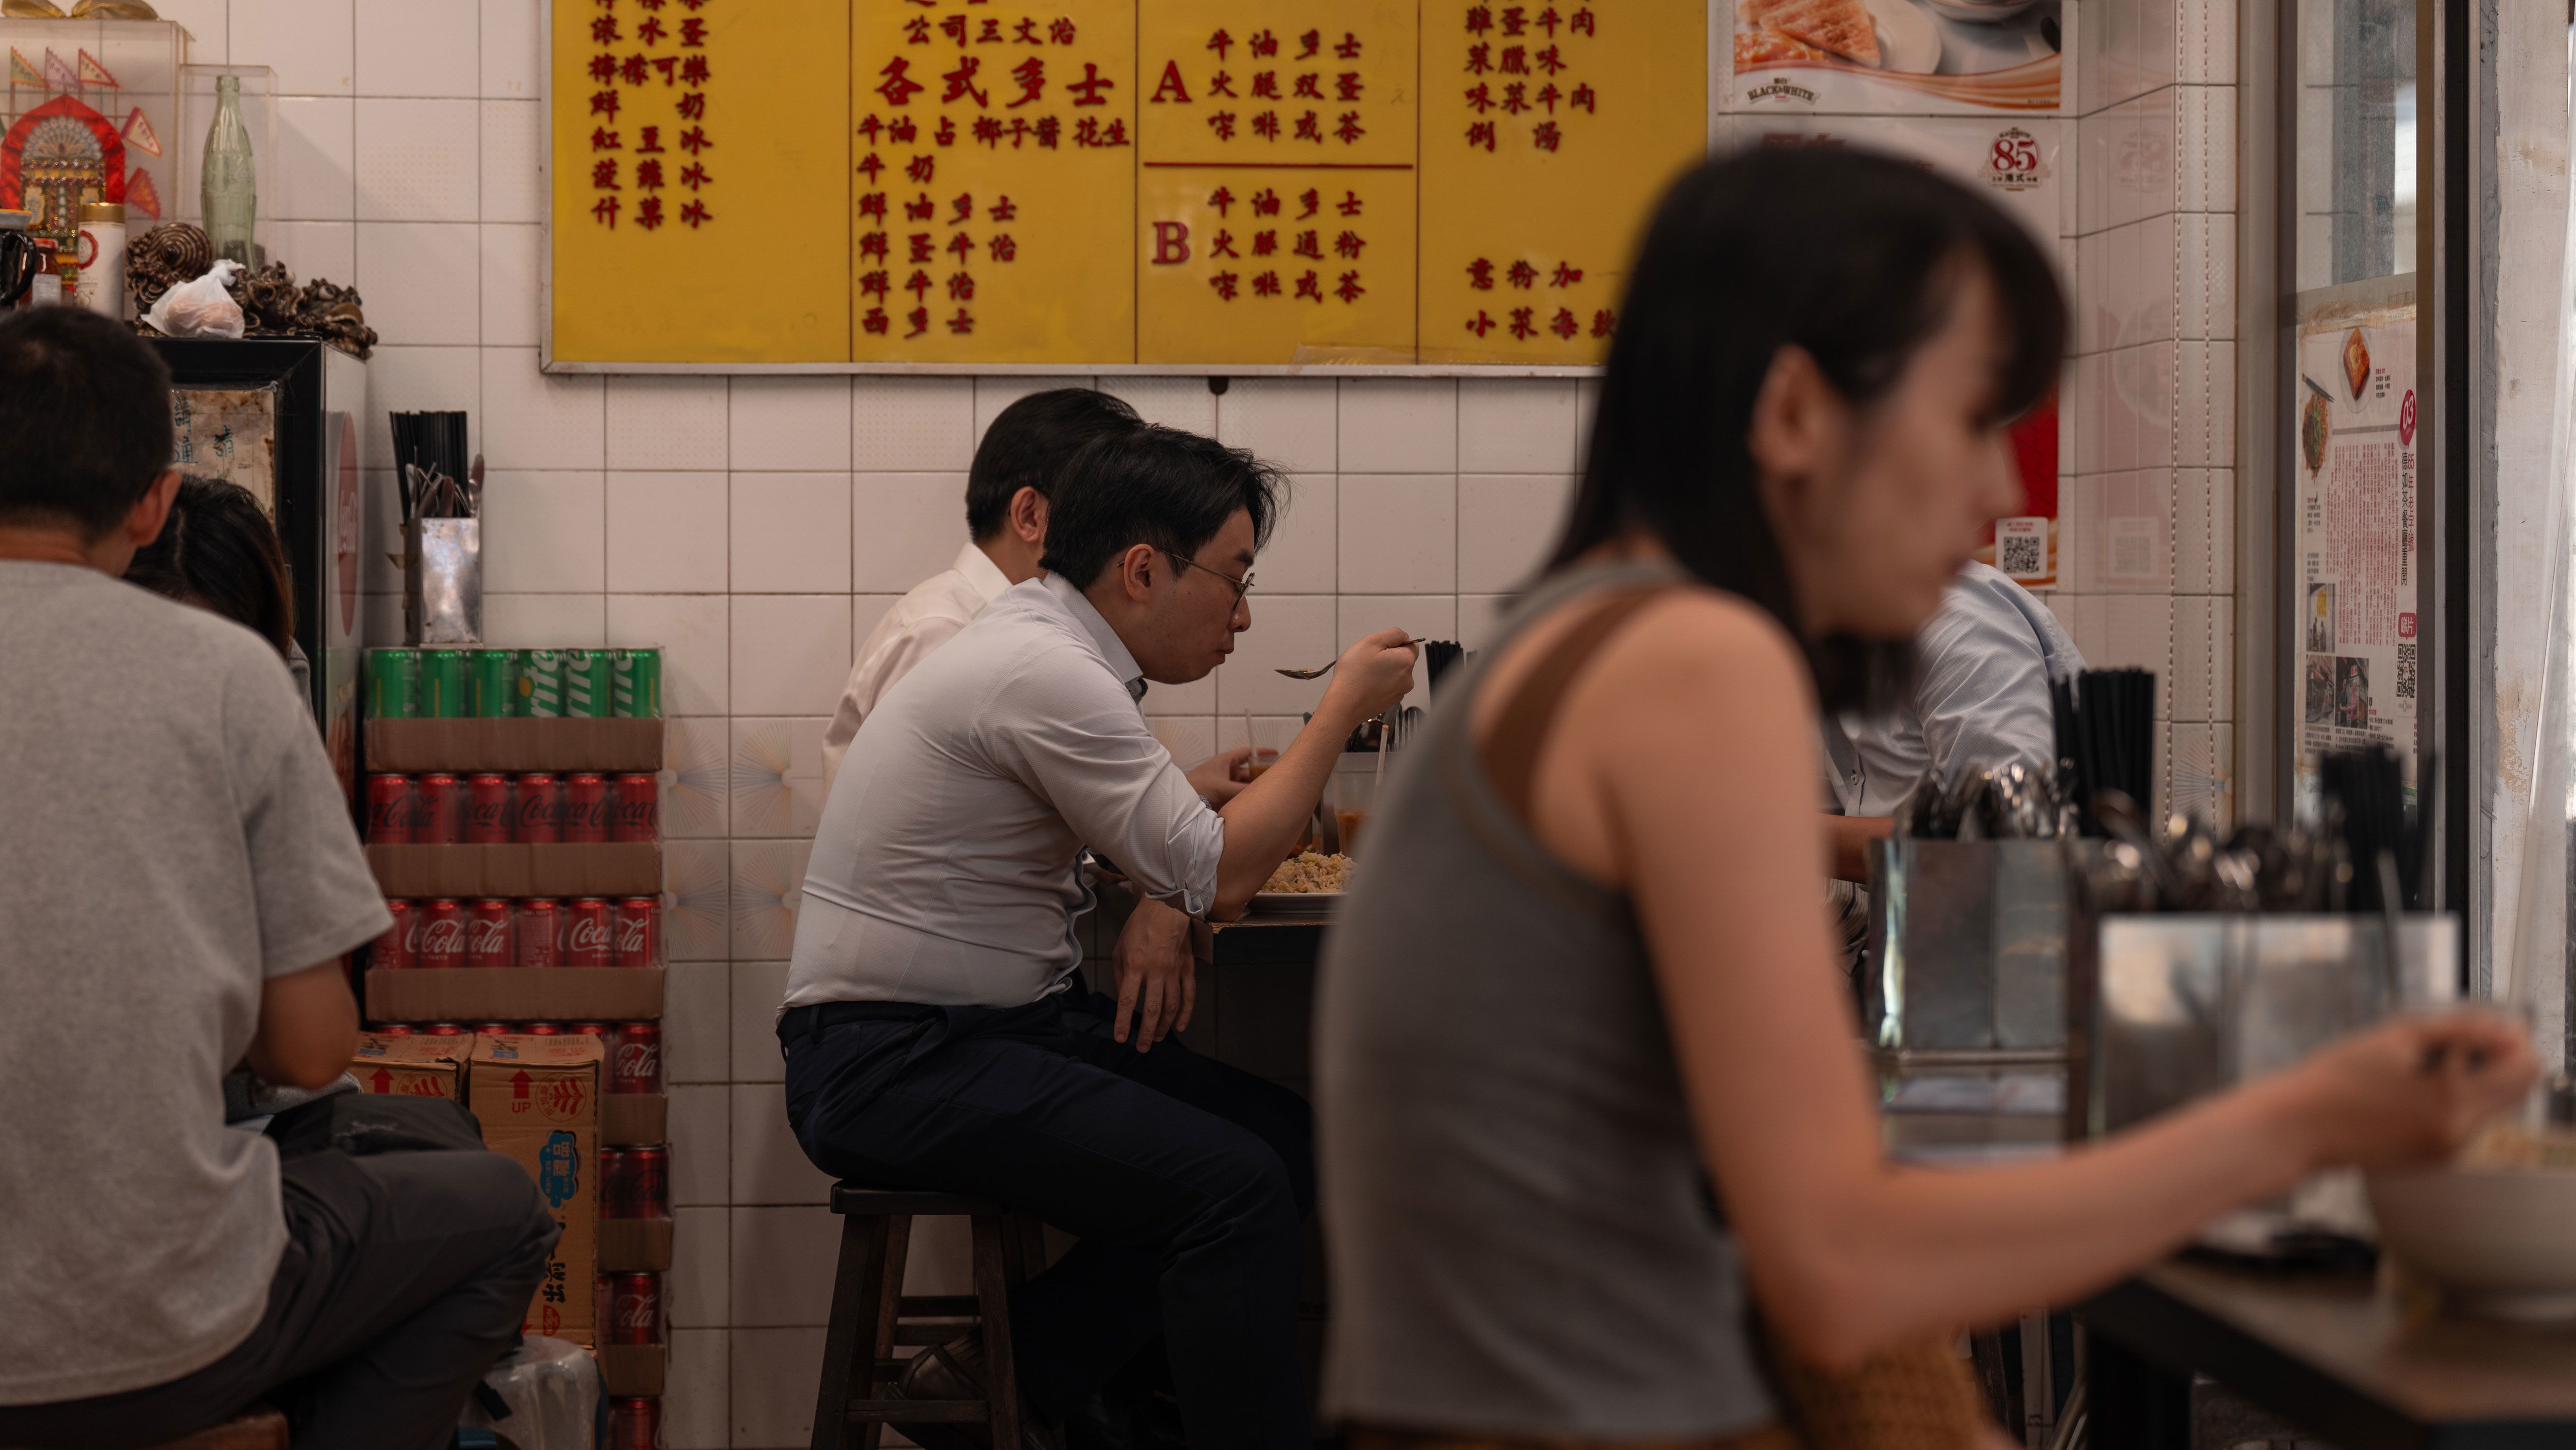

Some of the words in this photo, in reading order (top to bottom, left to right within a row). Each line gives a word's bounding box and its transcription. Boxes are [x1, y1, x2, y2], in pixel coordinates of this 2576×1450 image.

[904, 14, 1076, 48] 公司三文治
[1206, 28, 1362, 61] 牛油多士
[589, 53, 711, 89] 檸檬可樂
[875, 55, 1114, 109] 各式多士
[1150, 59, 1193, 103] A
[1464, 81, 1596, 115] 味菜牛肉
[590, 125, 713, 156] 紅豆冰
[1993, 139, 2037, 171] 85
[857, 152, 935, 184] 牛奶
[859, 191, 1017, 225] 鮮油多士
[1208, 186, 1363, 220] 牛油多士
[860, 231, 1017, 266] 鮮蛋牛治
[1152, 221, 1190, 264] B
[1210, 228, 1366, 260] 火腿通粉
[860, 269, 975, 304] 鮮牛治
[862, 306, 974, 338] 西多士
[2403, 395, 2414, 430] 03
[523, 650, 558, 718] rite
[512, 1102, 531, 1114] UP
[544, 1308, 554, 1335] NISSIN
